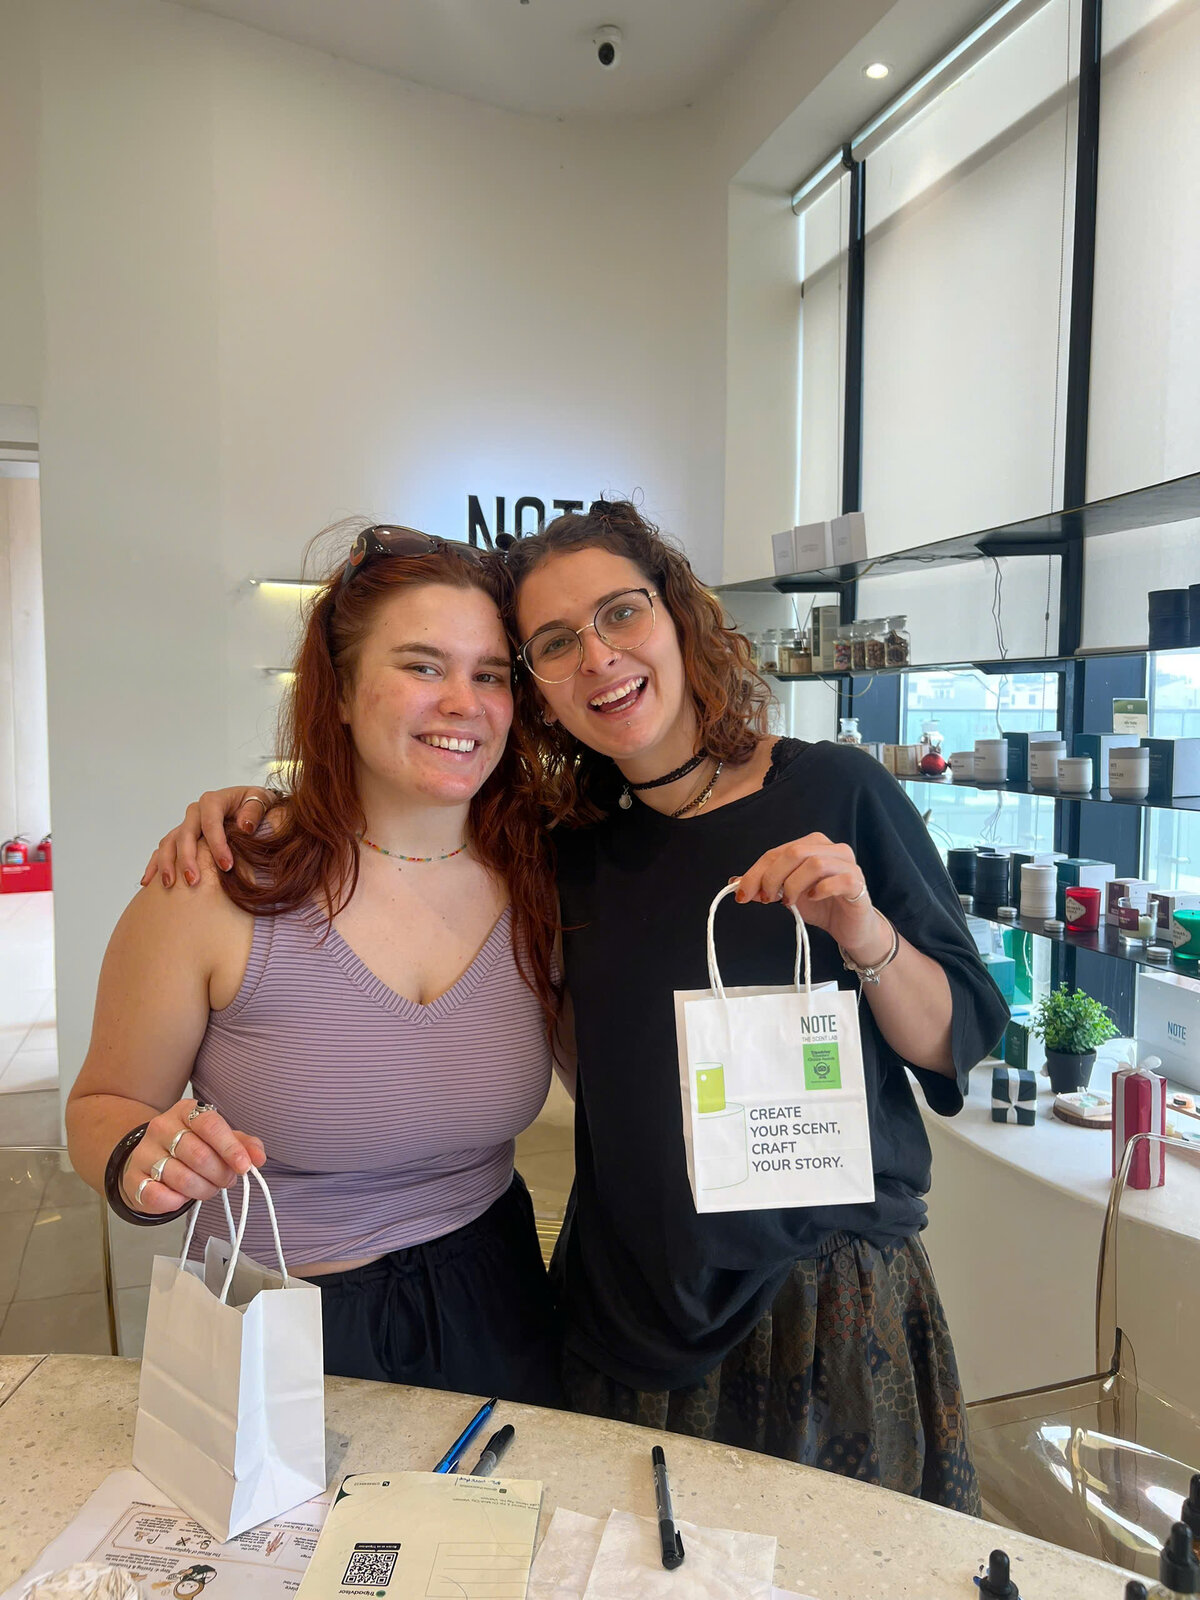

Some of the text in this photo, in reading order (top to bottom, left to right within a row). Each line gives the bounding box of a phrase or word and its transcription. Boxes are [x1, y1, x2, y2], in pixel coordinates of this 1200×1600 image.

[468, 494, 598, 551] NO
[800, 1014, 837, 1034] NOTE
[1167, 1021, 1187, 1040] NOTE
[749, 1106, 802, 1121] CREATE
[750, 1122, 841, 1138] YOUR SCENT,
[752, 1141, 797, 1155] CRAFT
[752, 1156, 844, 1172] YOUR STORY.
